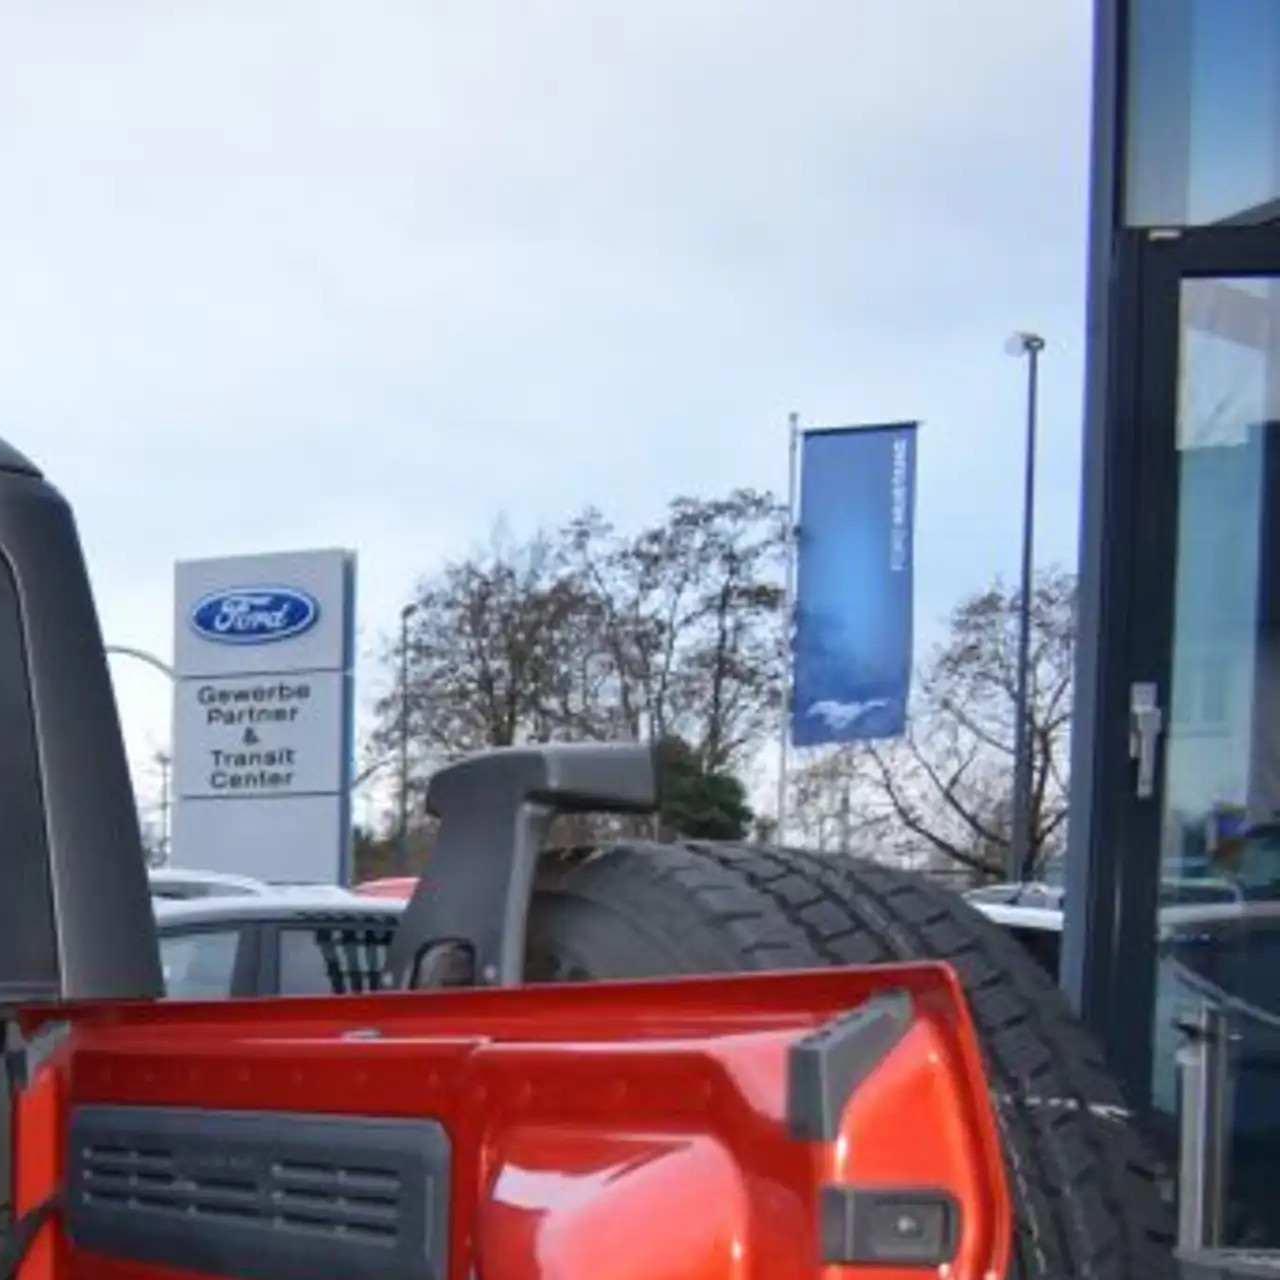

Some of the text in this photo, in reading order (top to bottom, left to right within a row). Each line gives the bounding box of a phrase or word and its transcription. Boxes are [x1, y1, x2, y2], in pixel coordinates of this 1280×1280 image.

[214, 596, 291, 632] Ford
[197, 682, 311, 706] Gewerbe
[206, 706, 299, 726] Partner
[242, 726, 260, 746] &
[210, 748, 296, 767] Transit
[209, 770, 294, 789] Center
